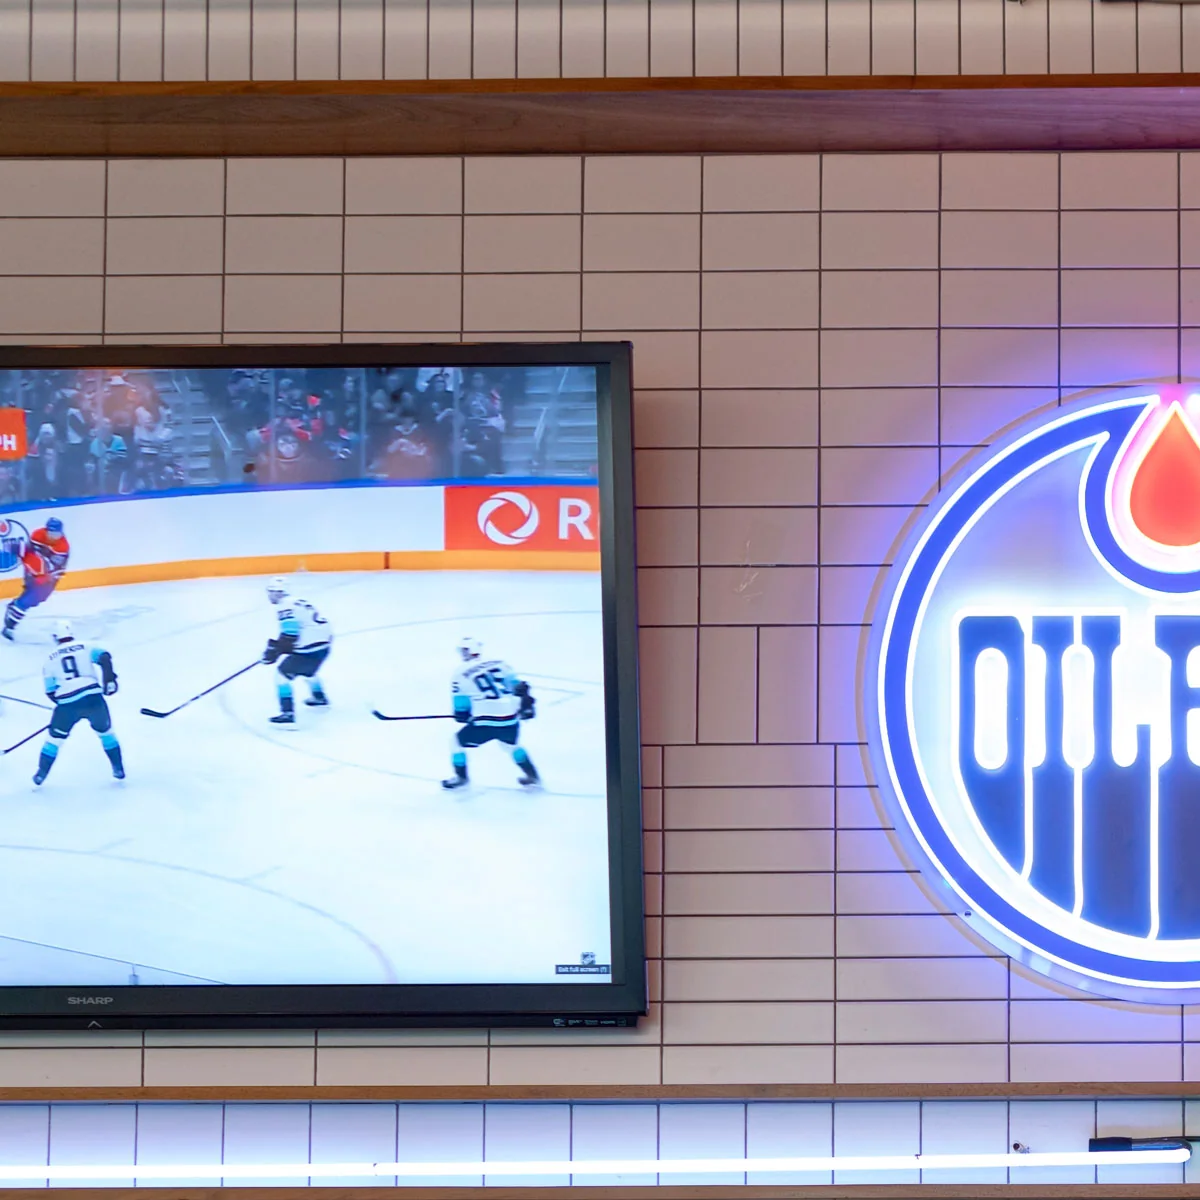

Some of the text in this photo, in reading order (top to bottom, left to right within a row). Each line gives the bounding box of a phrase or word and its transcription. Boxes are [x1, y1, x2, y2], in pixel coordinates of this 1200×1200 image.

[0, 434, 17, 451] H
[558, 497, 595, 540] R
[61, 655, 79, 680] 9
[67, 996, 114, 1005] SHARP
